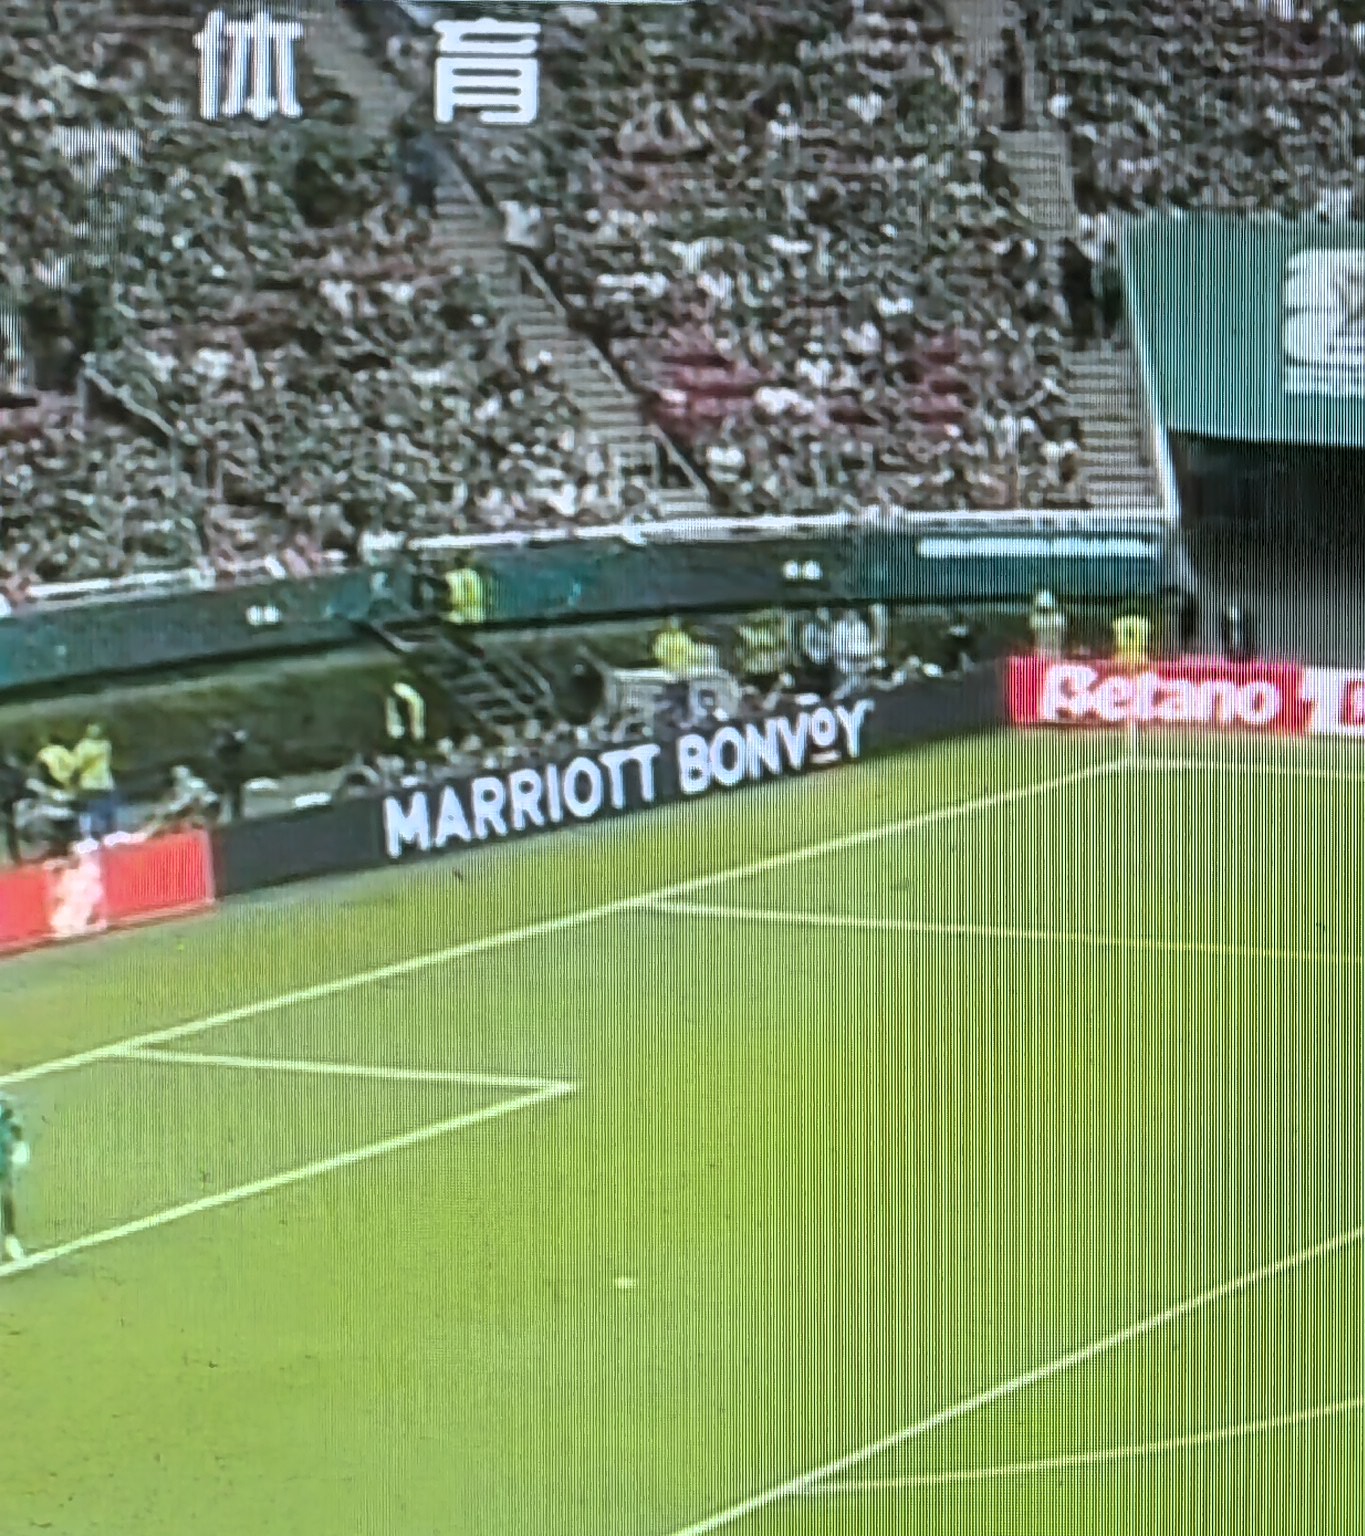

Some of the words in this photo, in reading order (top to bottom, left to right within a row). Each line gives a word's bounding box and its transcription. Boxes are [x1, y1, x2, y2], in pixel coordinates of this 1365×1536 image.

[195, 10, 541, 126] 体育
[1040, 663, 1282, 726] Betano
[384, 744, 661, 857] MARRIOTT
[678, 699, 875, 797] BONVOY
